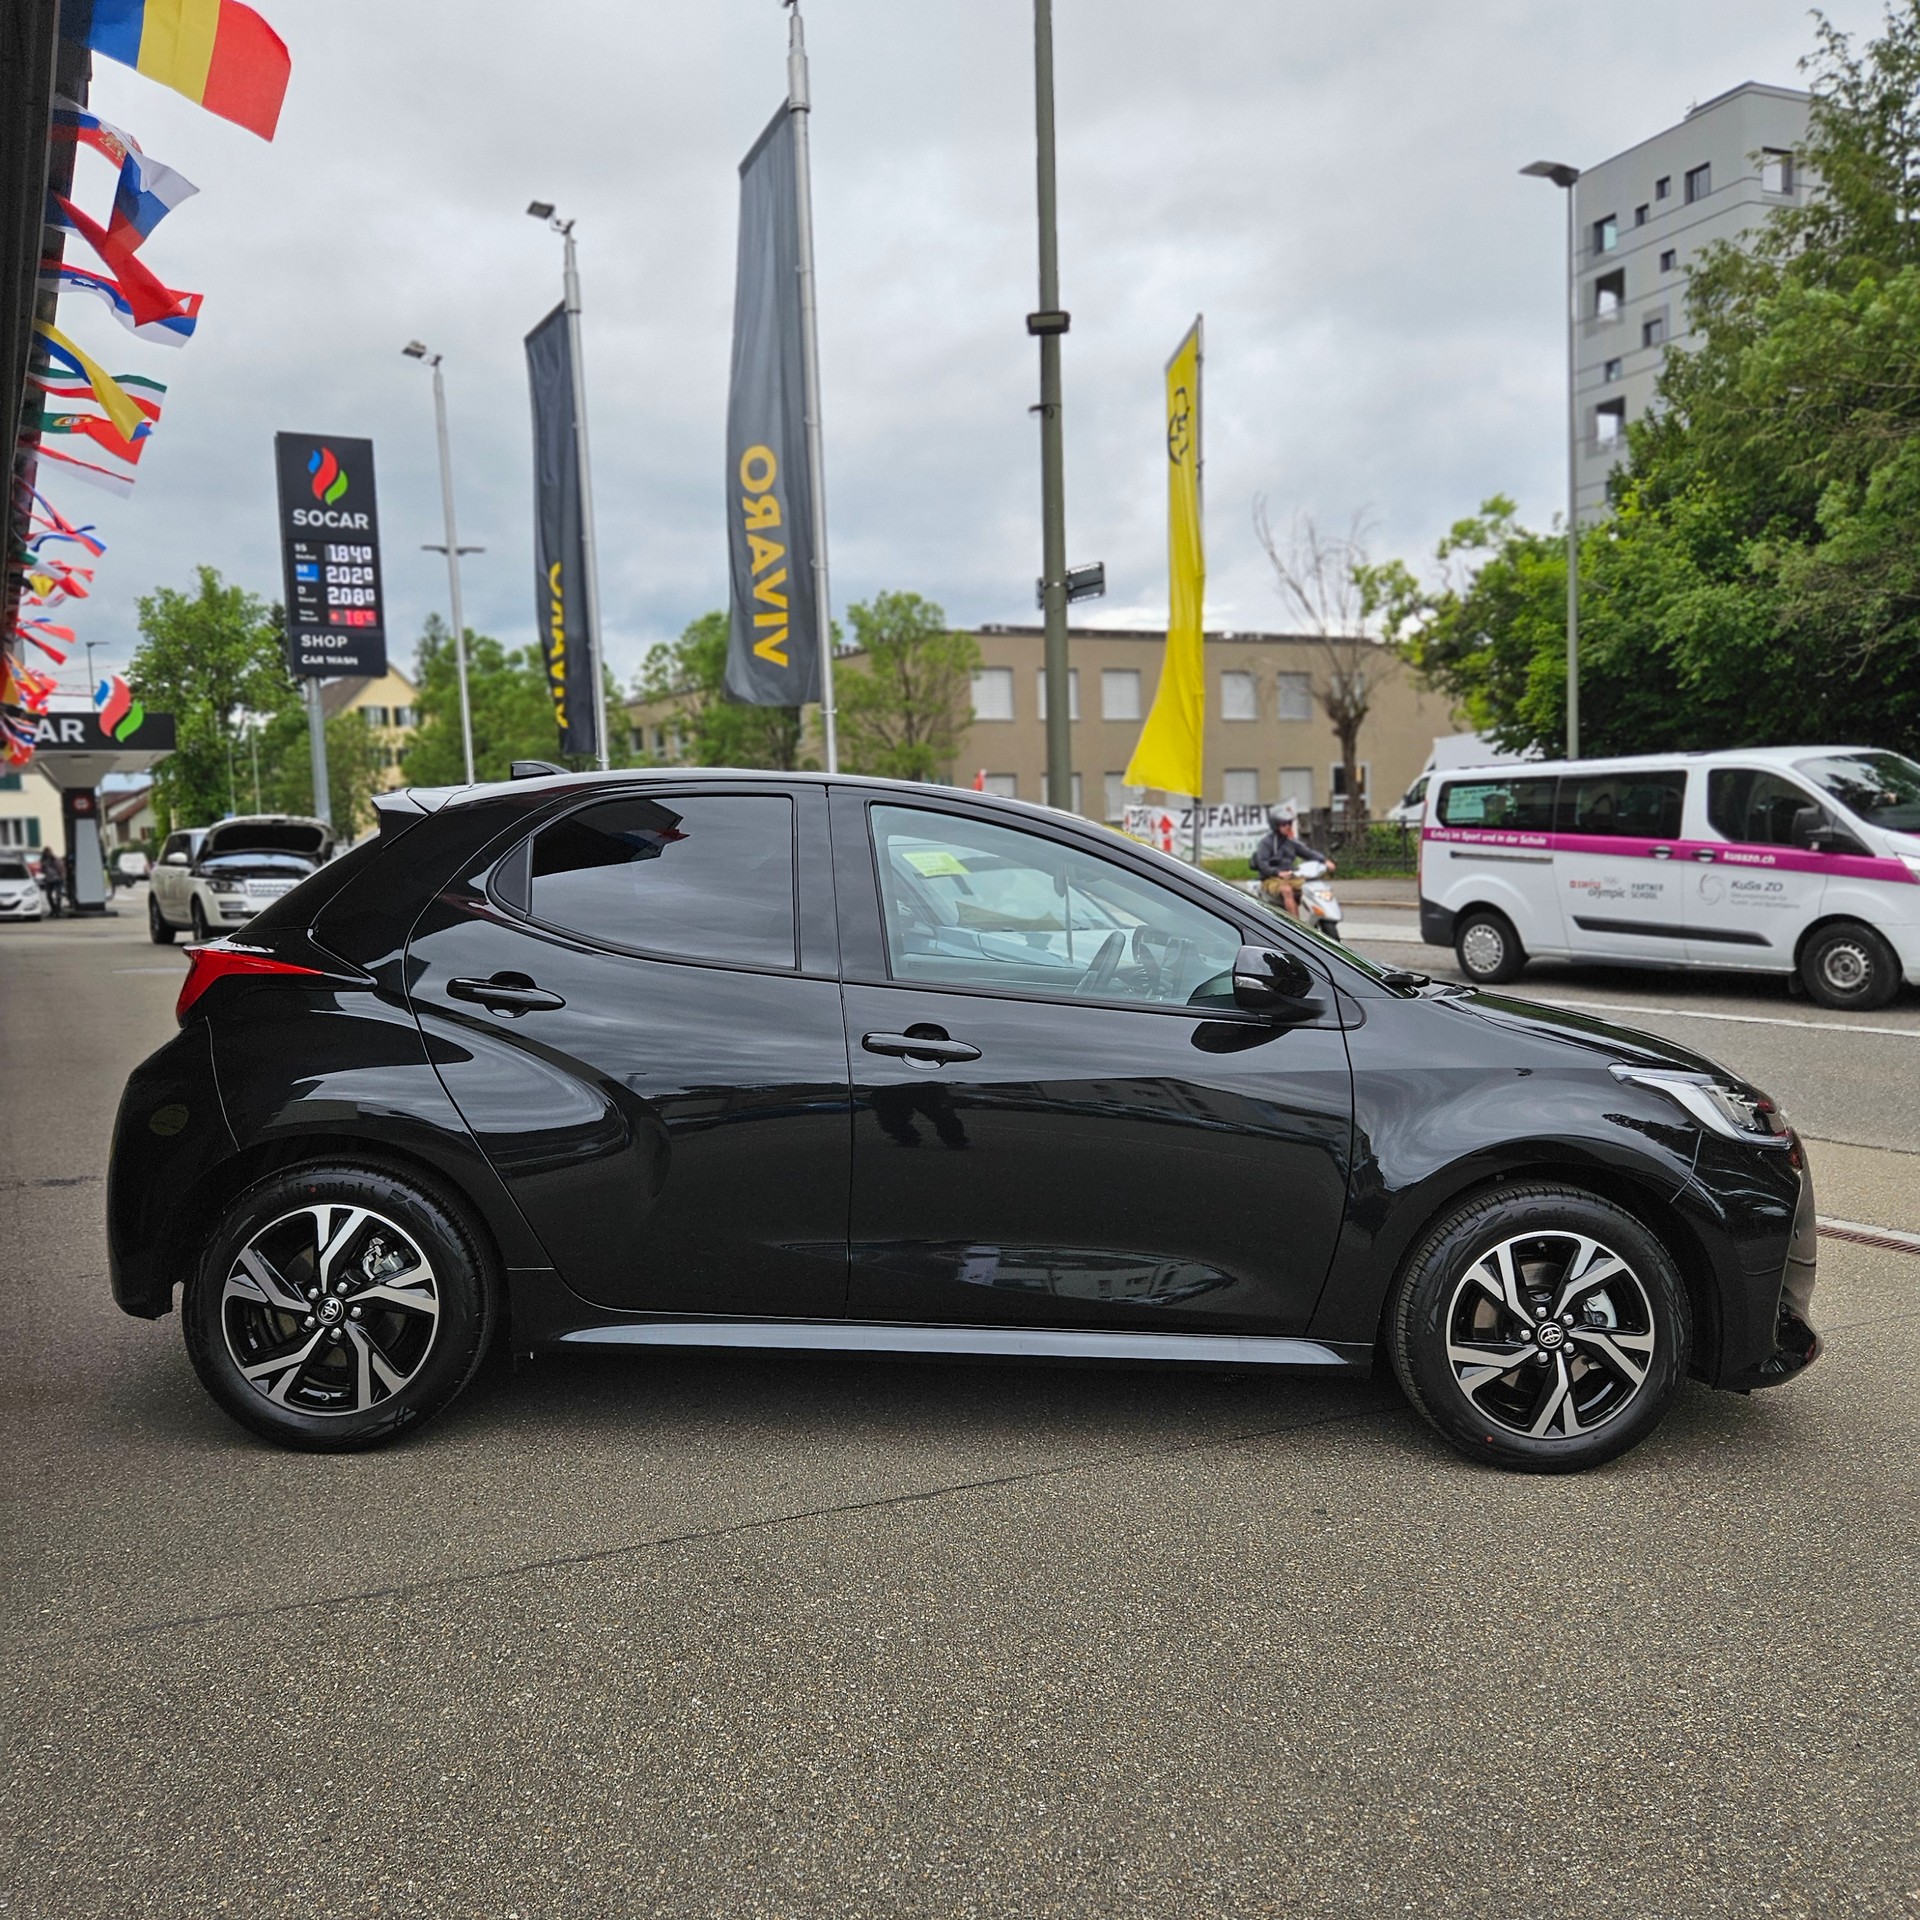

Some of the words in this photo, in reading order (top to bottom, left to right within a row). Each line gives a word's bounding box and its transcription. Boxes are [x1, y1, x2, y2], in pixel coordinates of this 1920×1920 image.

[292, 508, 369, 530] SOCAR
[300, 634, 348, 649] SHOP
[301, 654, 325, 665] CAR
[326, 655, 359, 666] WASH
[33, 718, 86, 743] AR
